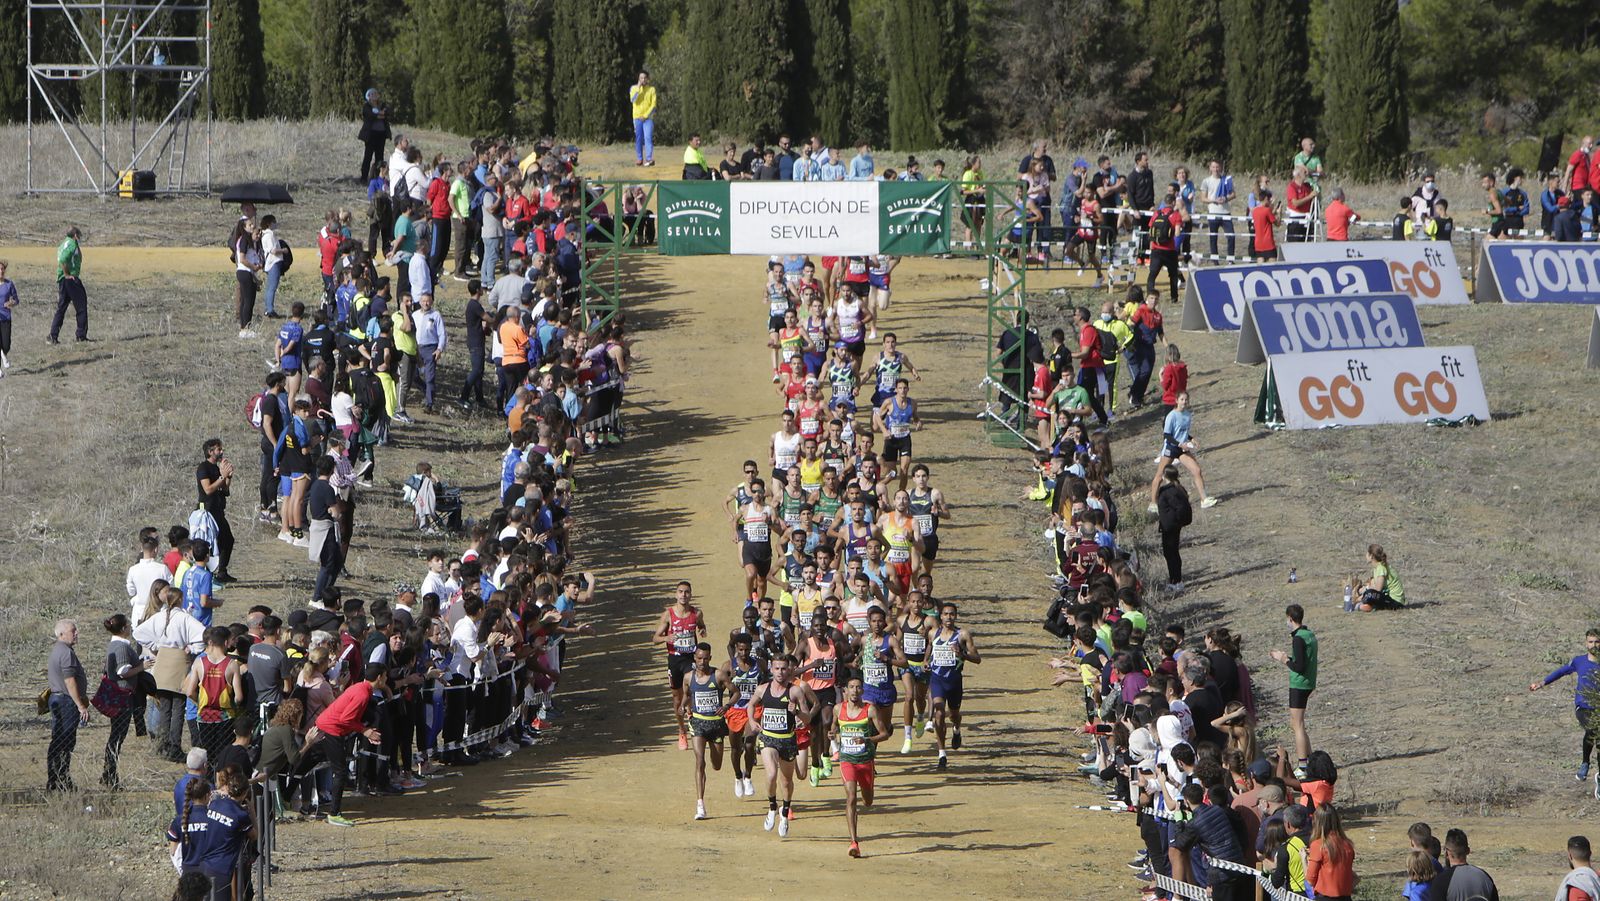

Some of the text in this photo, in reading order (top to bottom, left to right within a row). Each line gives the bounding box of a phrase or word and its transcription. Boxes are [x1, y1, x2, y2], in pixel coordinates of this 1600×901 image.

[665, 200, 723, 214] DIPUTACION
[739, 198, 870, 215] DIPUTACIÓN DE
[887, 198, 944, 212] DIPUTACON
[667, 226, 721, 237] SEVILLA
[771, 225, 839, 239] SEVILLA
[888, 224, 942, 235] SEVILLA
[1425, 247, 1445, 267] fit
[1298, 359, 1371, 421] GO fit
[1394, 355, 1465, 417] GO fit
[697, 697, 718, 706] WORKU
[764, 715, 785, 724] MAYO
[206, 809, 234, 827] CAPEX
